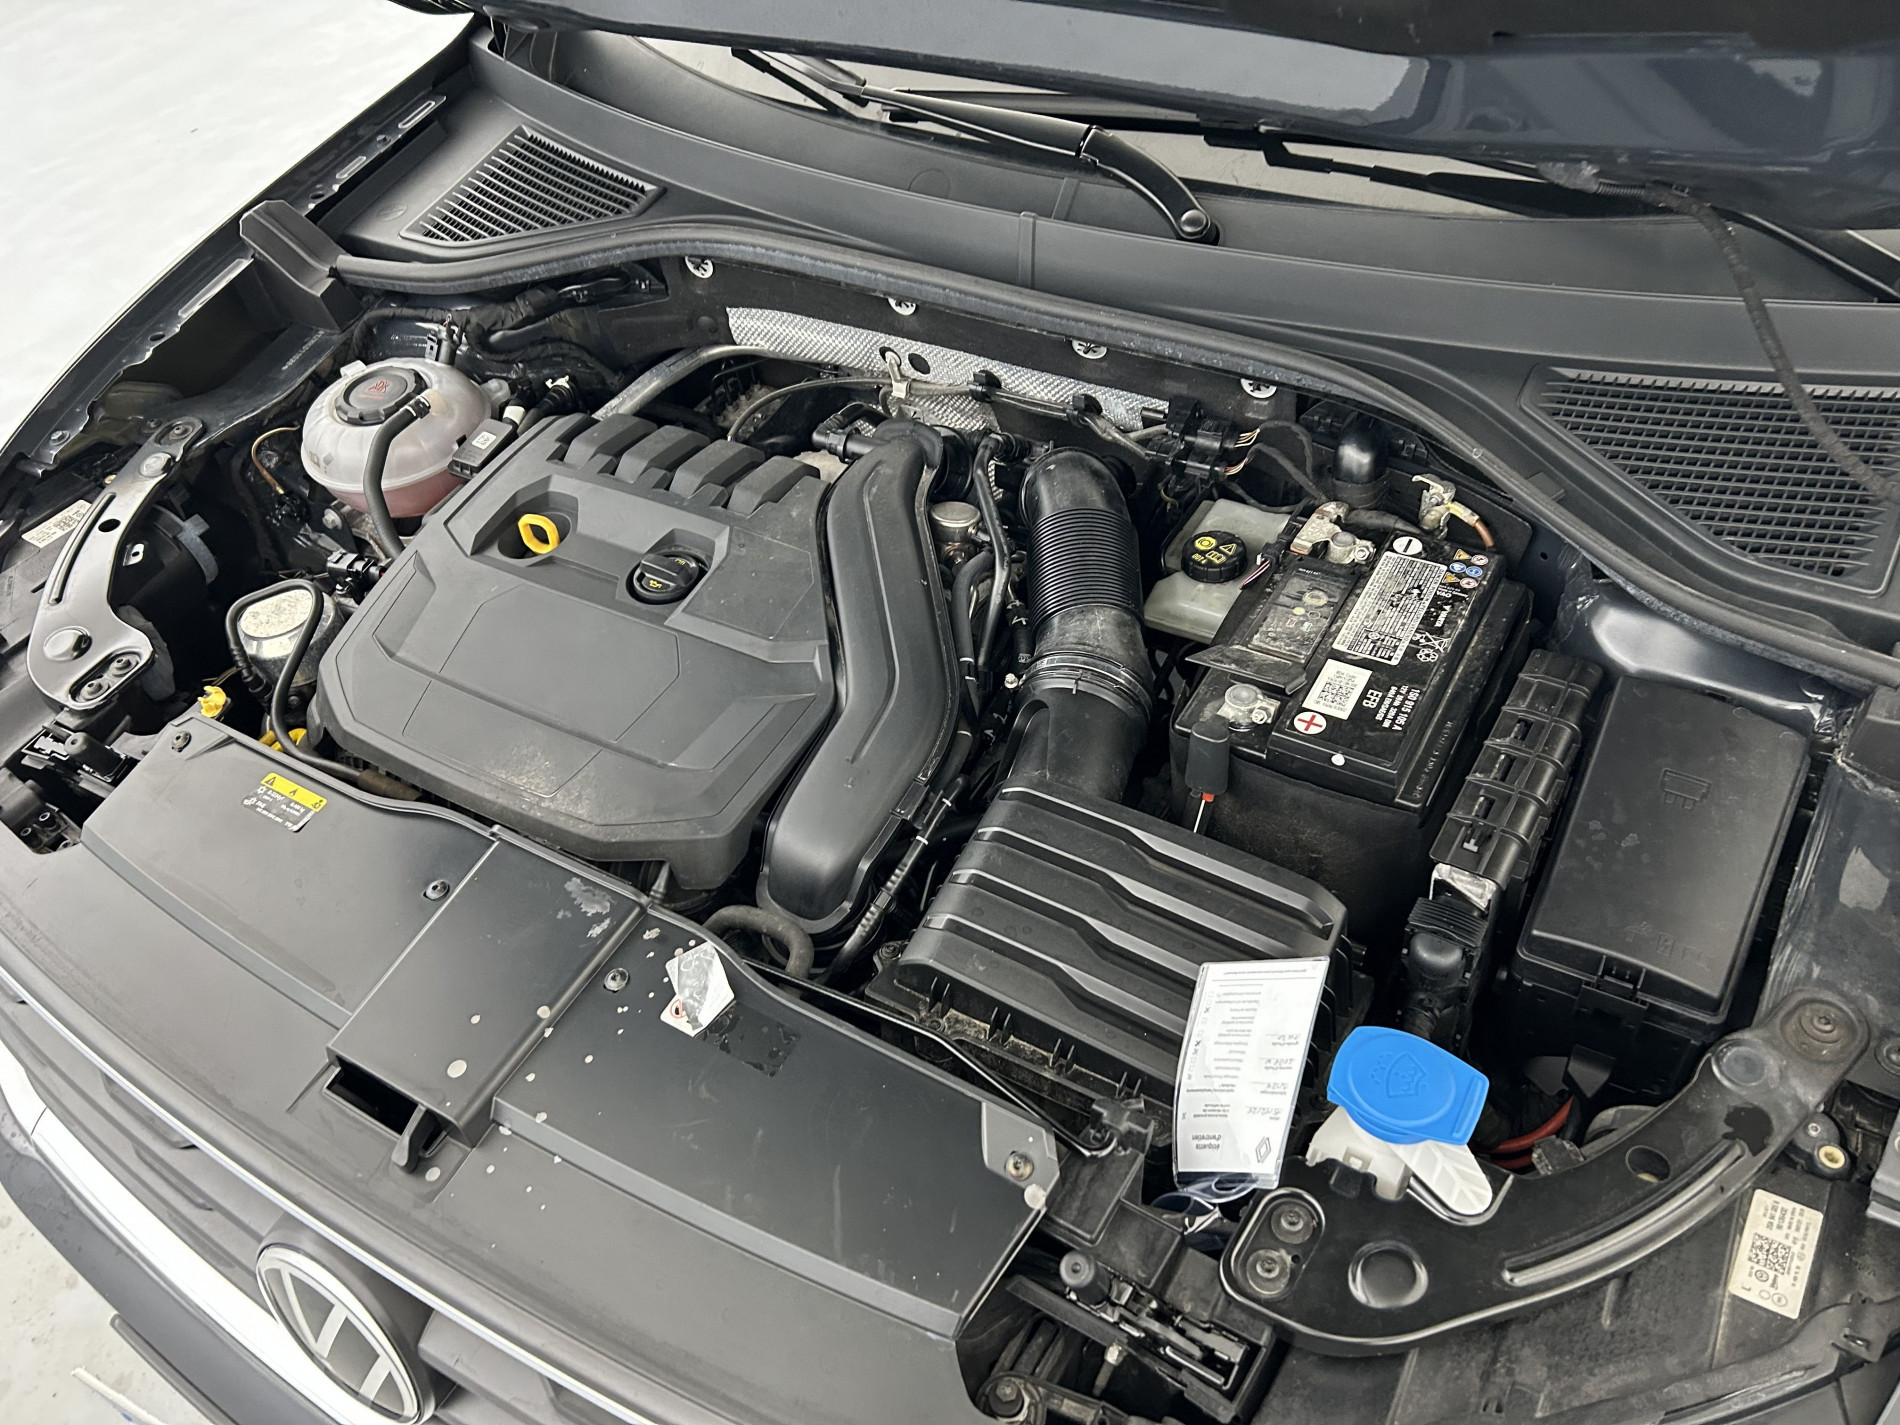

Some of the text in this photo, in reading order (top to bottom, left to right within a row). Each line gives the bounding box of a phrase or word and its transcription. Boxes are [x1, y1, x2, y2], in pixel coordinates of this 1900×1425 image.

[1434, 611, 1450, 627] VARTA
[1362, 689, 1383, 709] EFB
[1401, 699, 1414, 712] 915
[1395, 712, 1407, 726] 105
